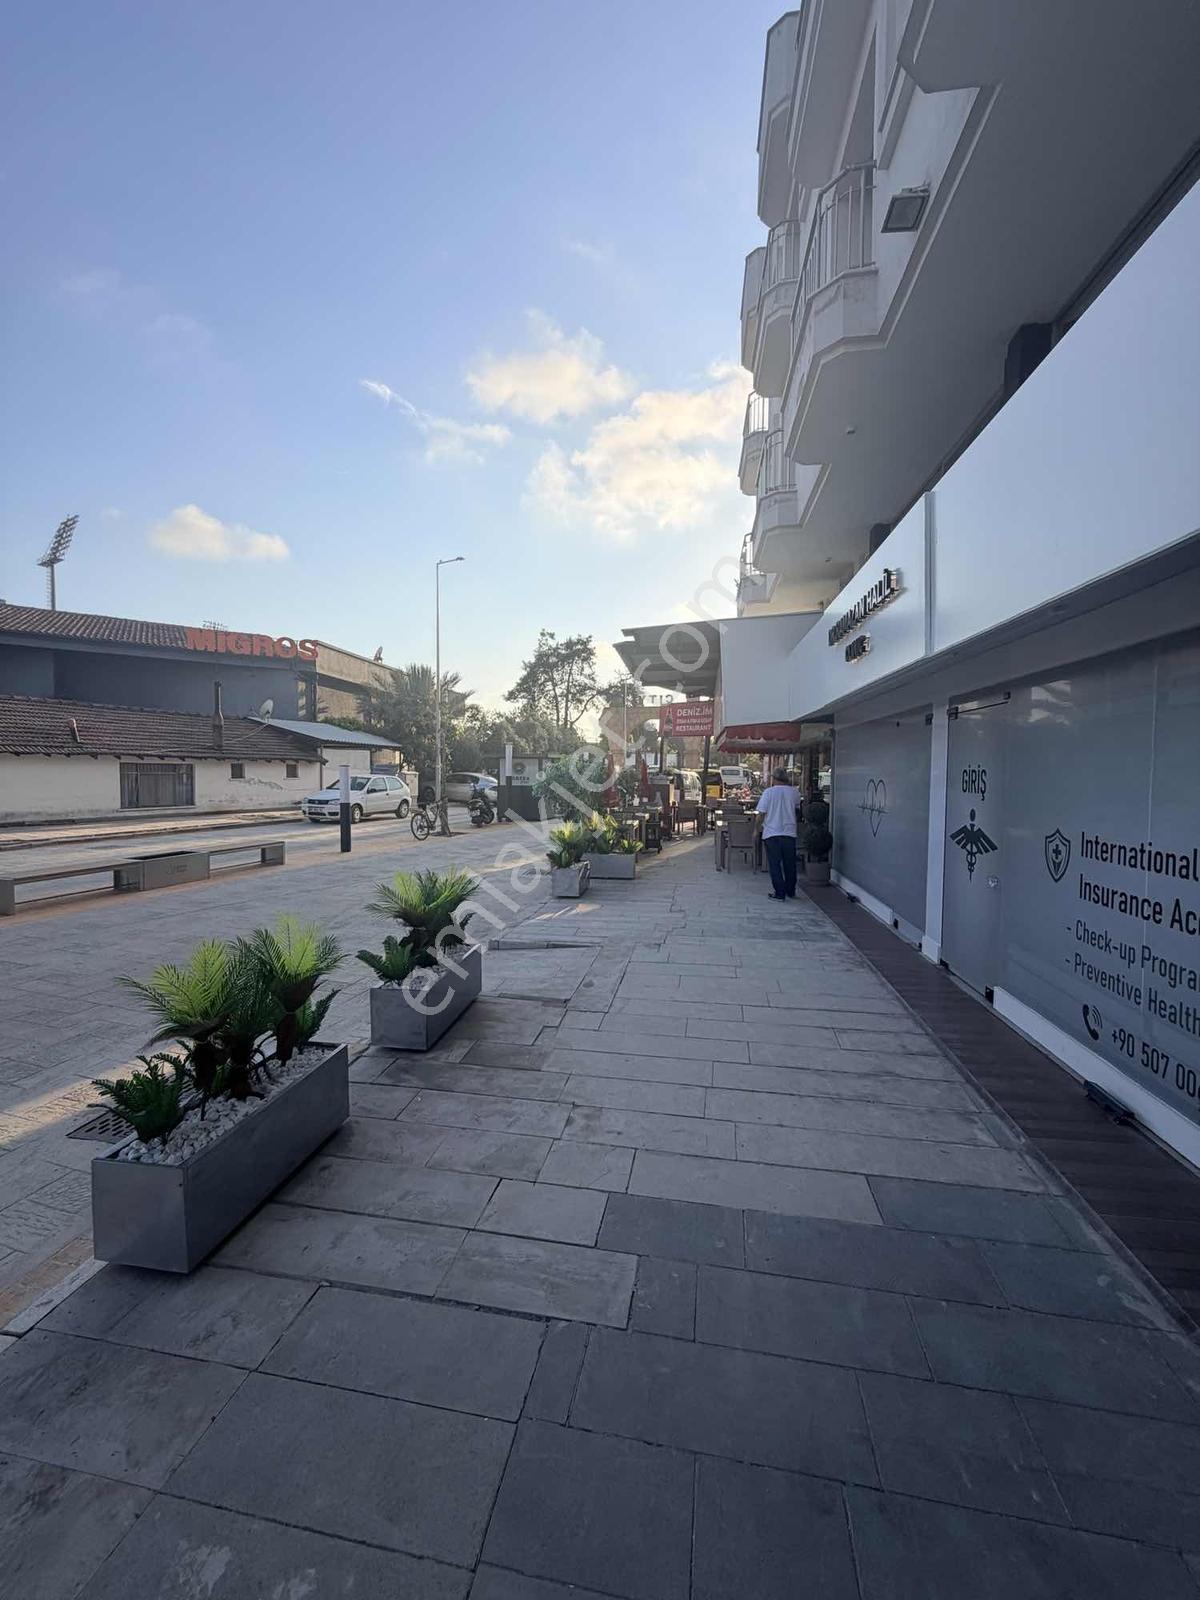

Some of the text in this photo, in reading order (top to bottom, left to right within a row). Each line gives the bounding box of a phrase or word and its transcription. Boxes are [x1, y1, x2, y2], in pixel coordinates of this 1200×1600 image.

[962, 764, 987, 801] GİRİŞ
[1081, 831, 1199, 882] International
[1079, 873, 1200, 935] Insurance Ac
[1074, 952, 1142, 1006] Preventive
[1076, 920, 1135, 968] Check-up
[1142, 945, 1200, 992] Progra
[1112, 1028, 1200, 1098] +90 507 00
